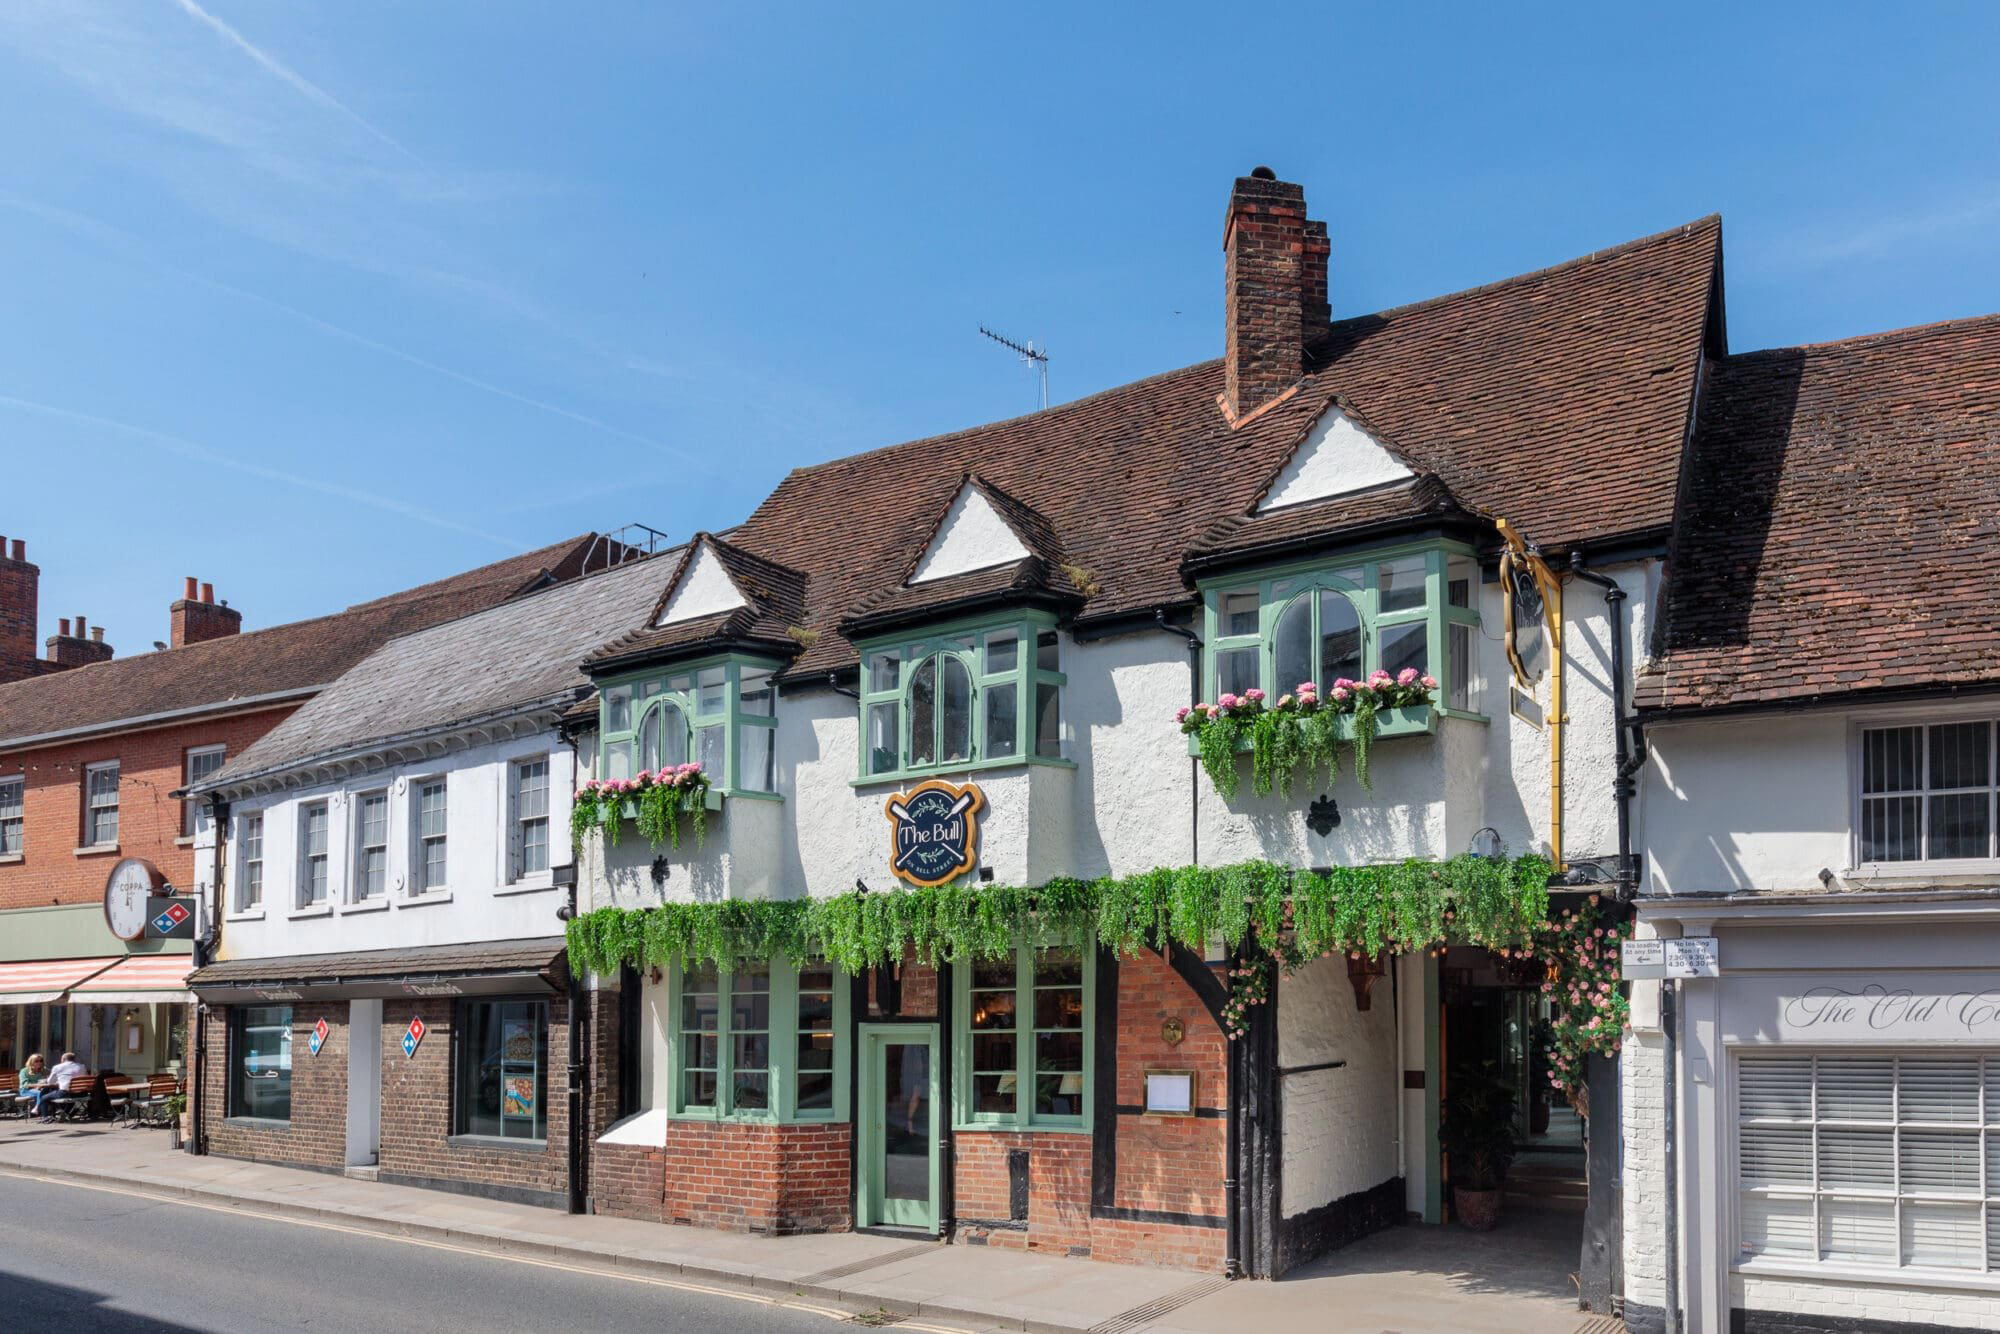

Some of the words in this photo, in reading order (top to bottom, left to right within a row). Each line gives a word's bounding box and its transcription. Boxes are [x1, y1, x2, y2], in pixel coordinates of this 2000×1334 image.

[901, 825, 932, 844] The
[933, 821, 959, 842] Bull
[906, 859, 914, 868] ON
[932, 856, 954, 873] STREET
[120, 883, 143, 892] COPPA
[1785, 987, 1856, 1027] The
[1863, 984, 1940, 1030] Old
